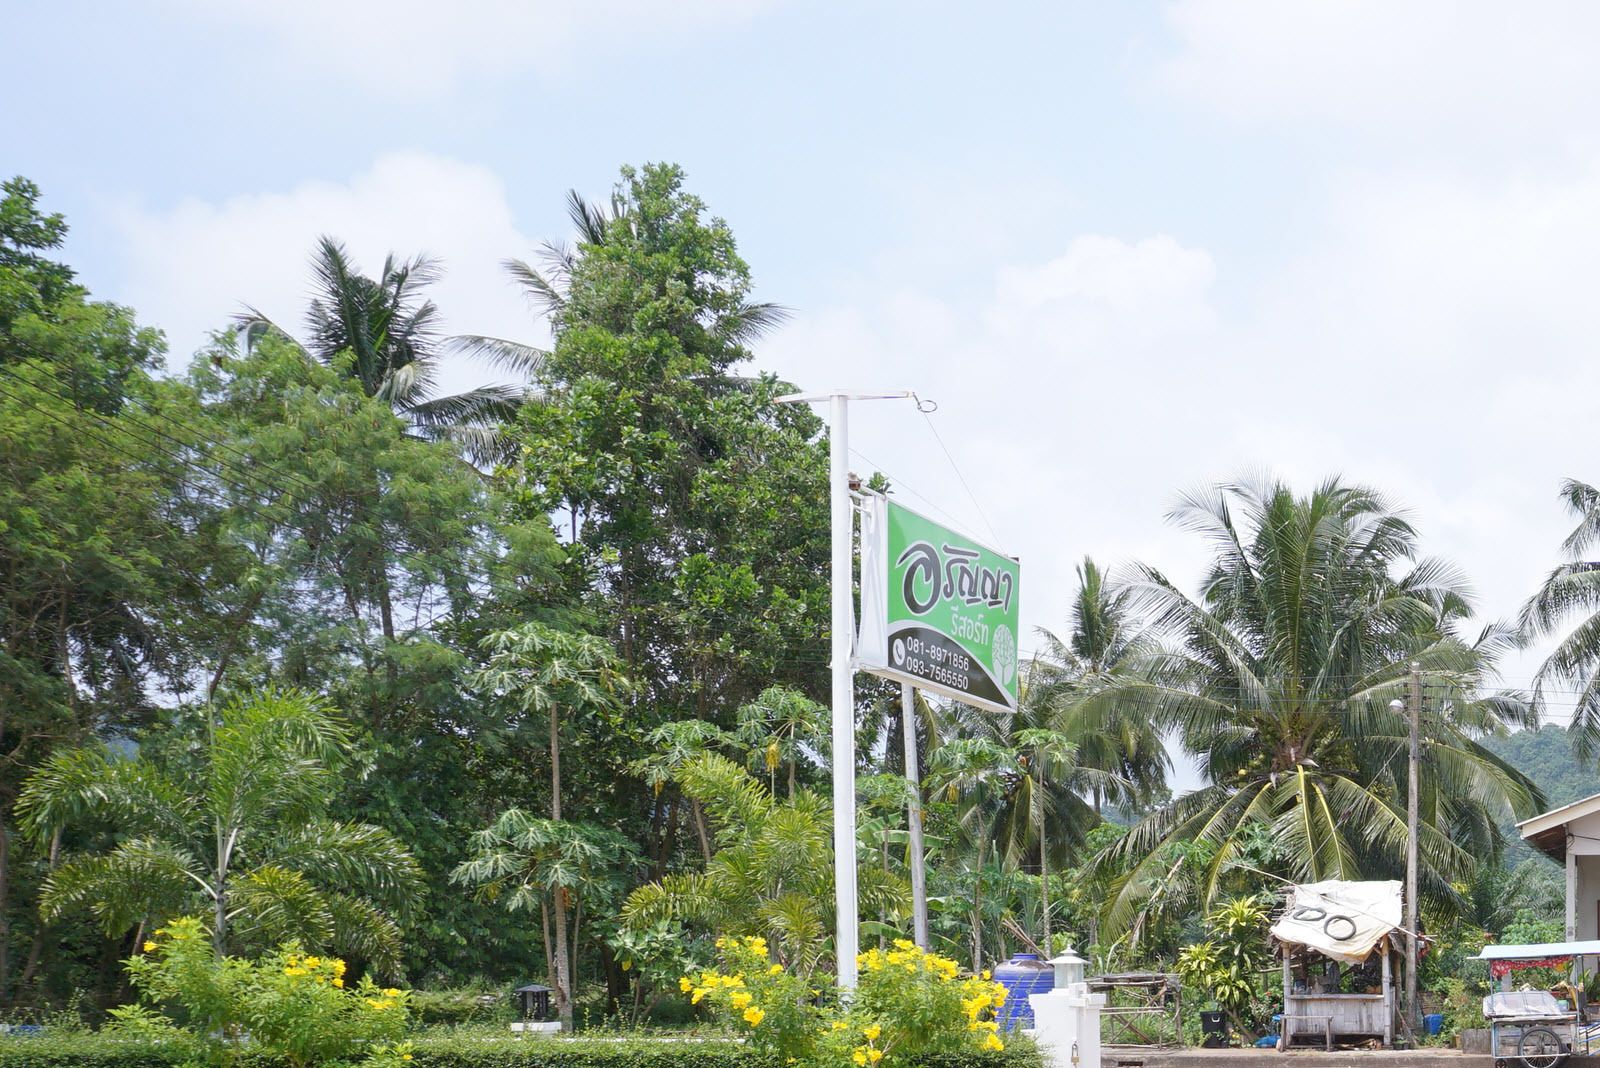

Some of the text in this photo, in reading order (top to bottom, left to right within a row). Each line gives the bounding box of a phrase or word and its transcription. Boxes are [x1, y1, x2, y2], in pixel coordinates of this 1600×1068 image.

[896, 542, 1013, 616] อรัญญา
[950, 605, 989, 645] รีสอร์ท
[906, 636, 970, 671] 081-8971856
[906, 656, 969, 690] 093-7565550
